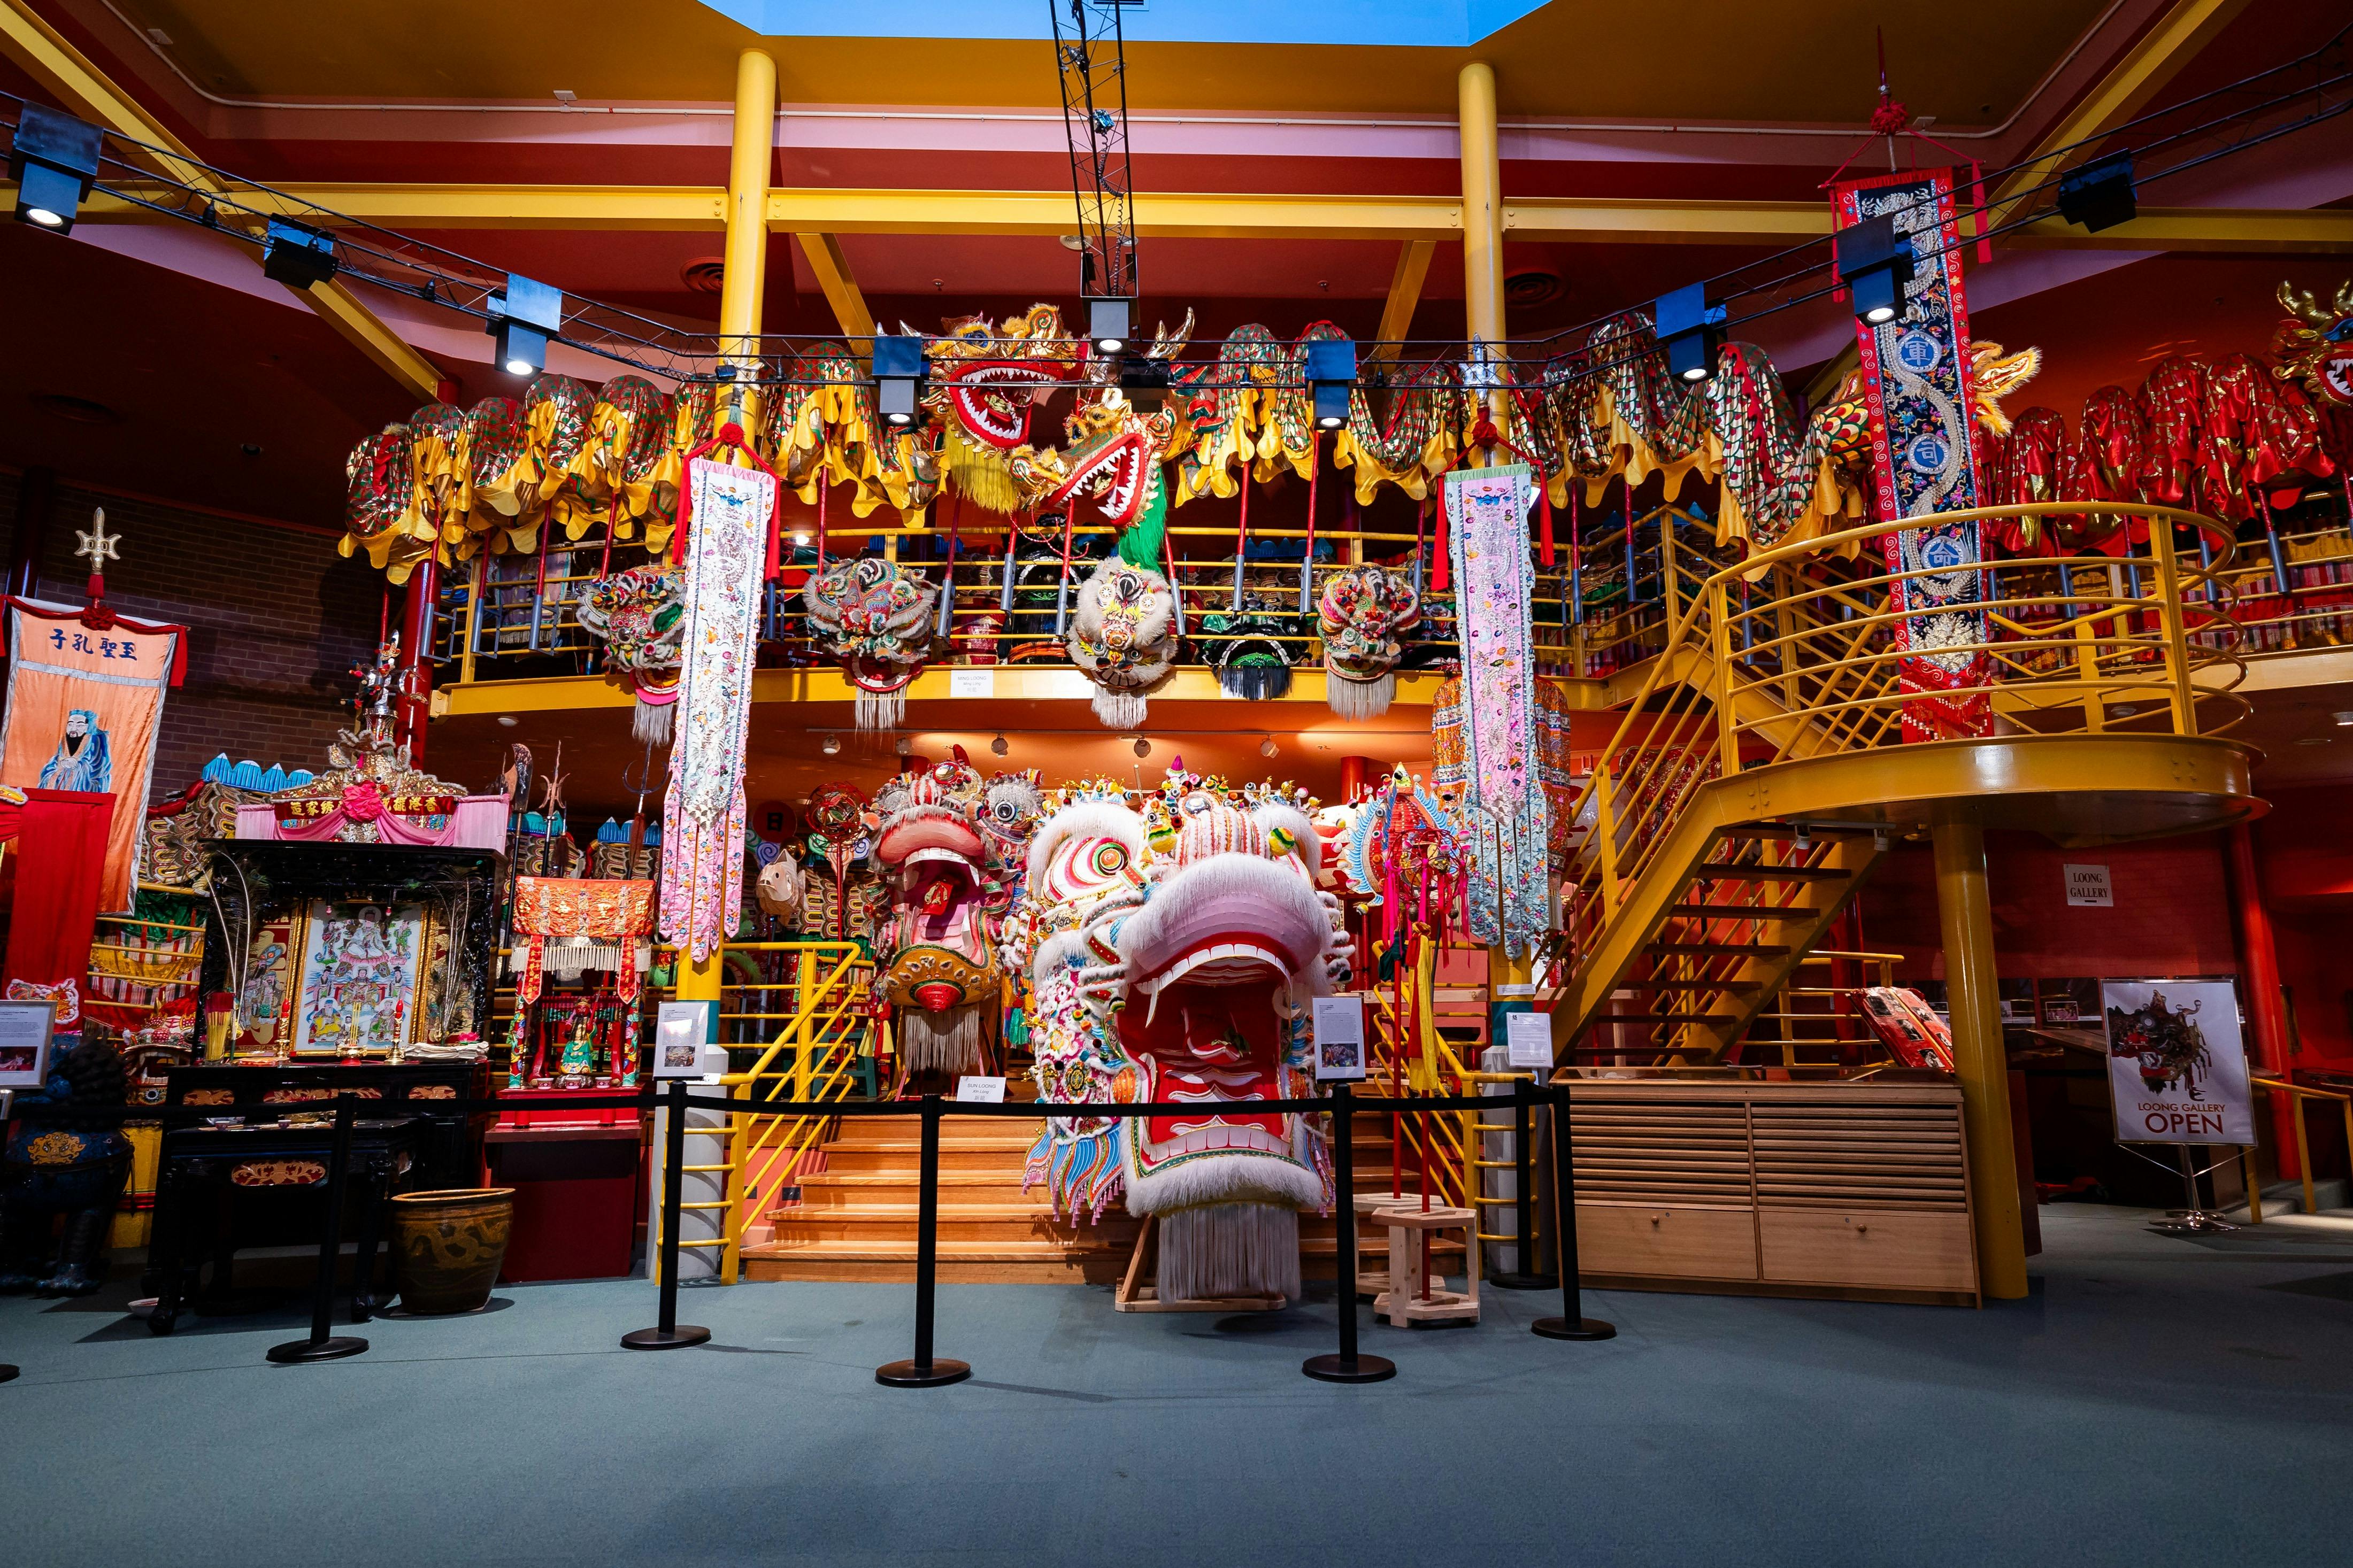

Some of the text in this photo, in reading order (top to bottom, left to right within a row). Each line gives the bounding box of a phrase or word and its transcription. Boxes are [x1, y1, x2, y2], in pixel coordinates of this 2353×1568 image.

[2073, 872, 2102, 883] LOONG
[2070, 887, 2108, 898] GALLERY
[2138, 1103, 2226, 1113] LOONG GALLERY
[2144, 1113, 2224, 1135] OPEN
